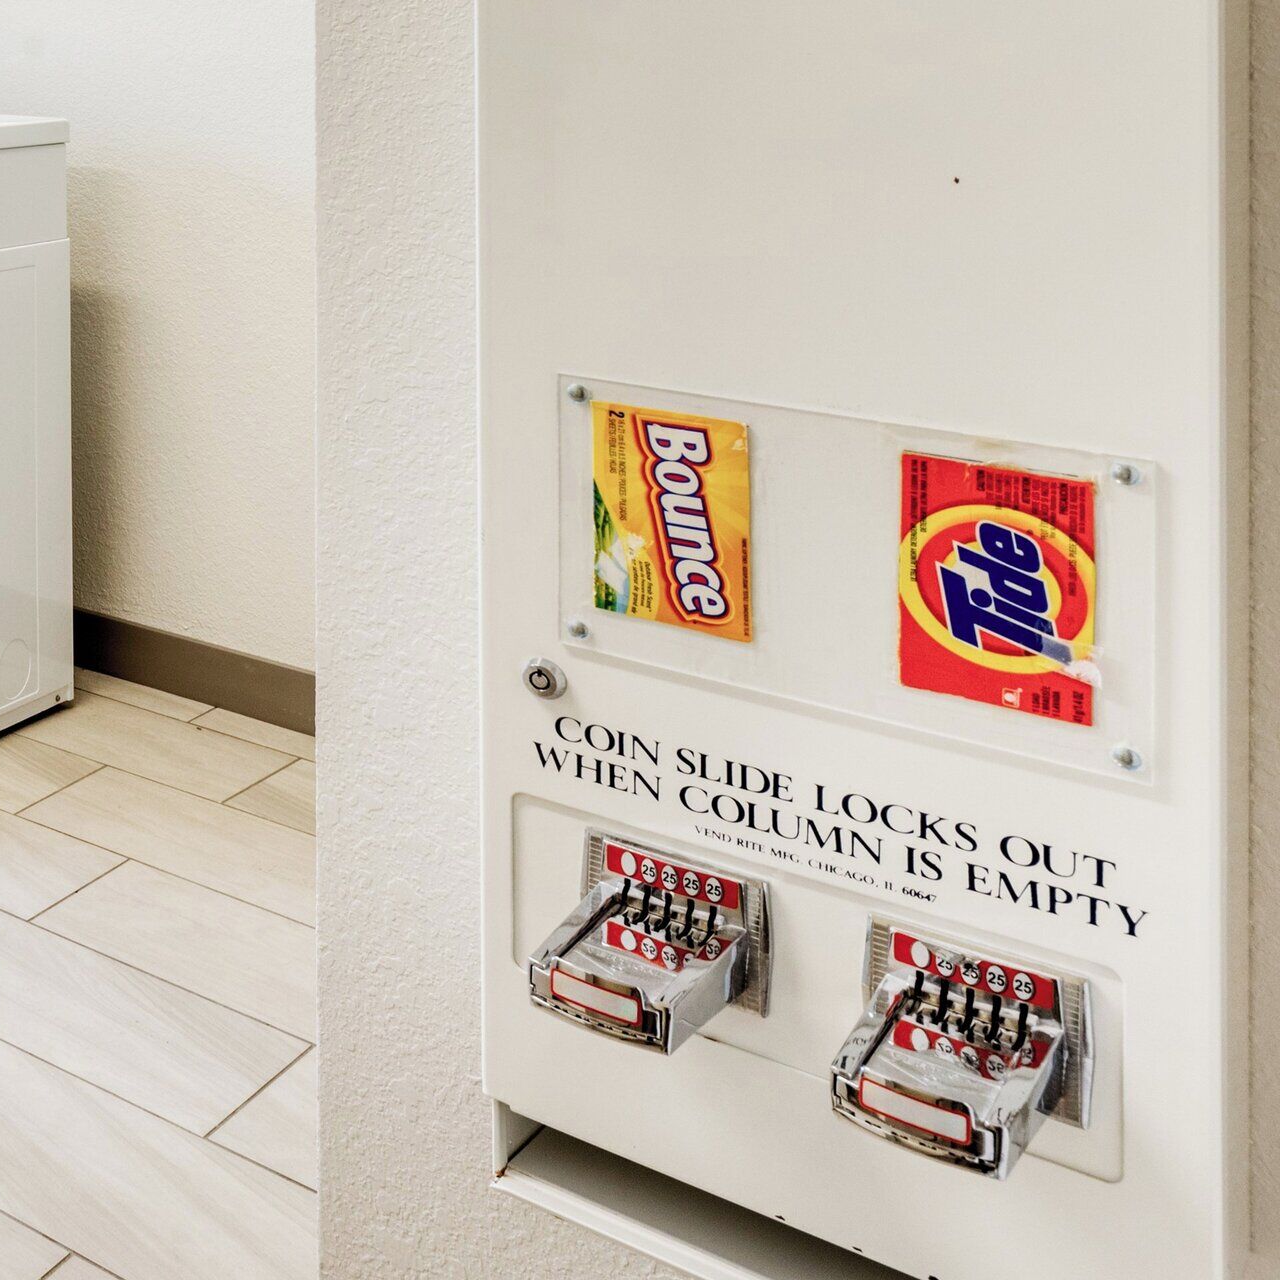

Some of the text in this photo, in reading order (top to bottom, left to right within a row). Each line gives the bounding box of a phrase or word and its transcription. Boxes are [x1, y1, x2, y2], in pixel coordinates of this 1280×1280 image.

[609, 410, 625, 418] 2
[645, 422, 728, 618] Bounce
[938, 521, 1073, 665] Tide
[533, 741, 1148, 938] WHEN COLUMN IS EMPTY
[554, 716, 1117, 888] COIN SLIDE LOCKS OUT
[642, 864, 721, 896] 25 25 25 25
[694, 824, 732, 843] VEND
[736, 837, 766, 854] RITE
[902, 886, 937, 903] 60647
[937, 956, 1032, 994] 25 25 25 25
